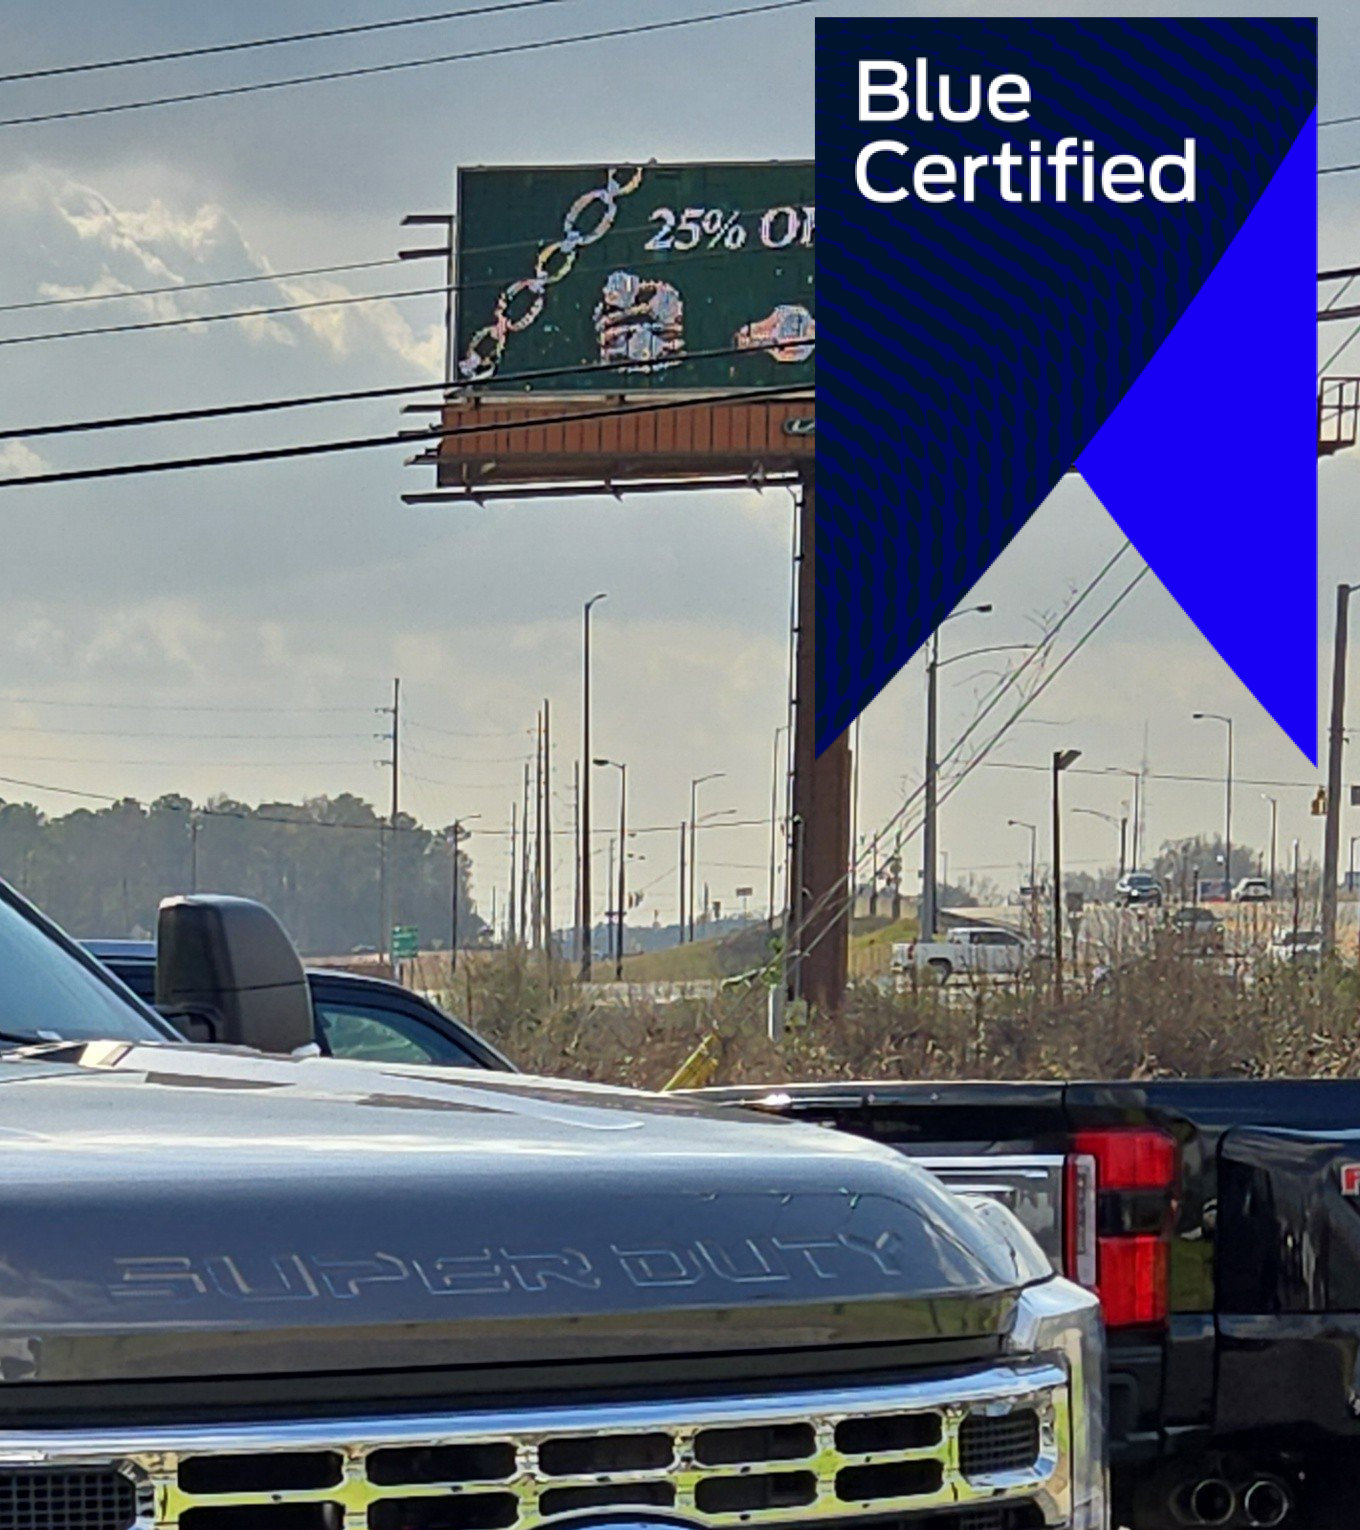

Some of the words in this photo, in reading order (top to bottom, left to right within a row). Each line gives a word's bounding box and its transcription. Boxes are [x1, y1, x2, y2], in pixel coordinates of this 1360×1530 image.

[644, 207, 747, 250] 25%
[106, 1245, 602, 1301] SUPER
[610, 1231, 902, 1288] DUTY
